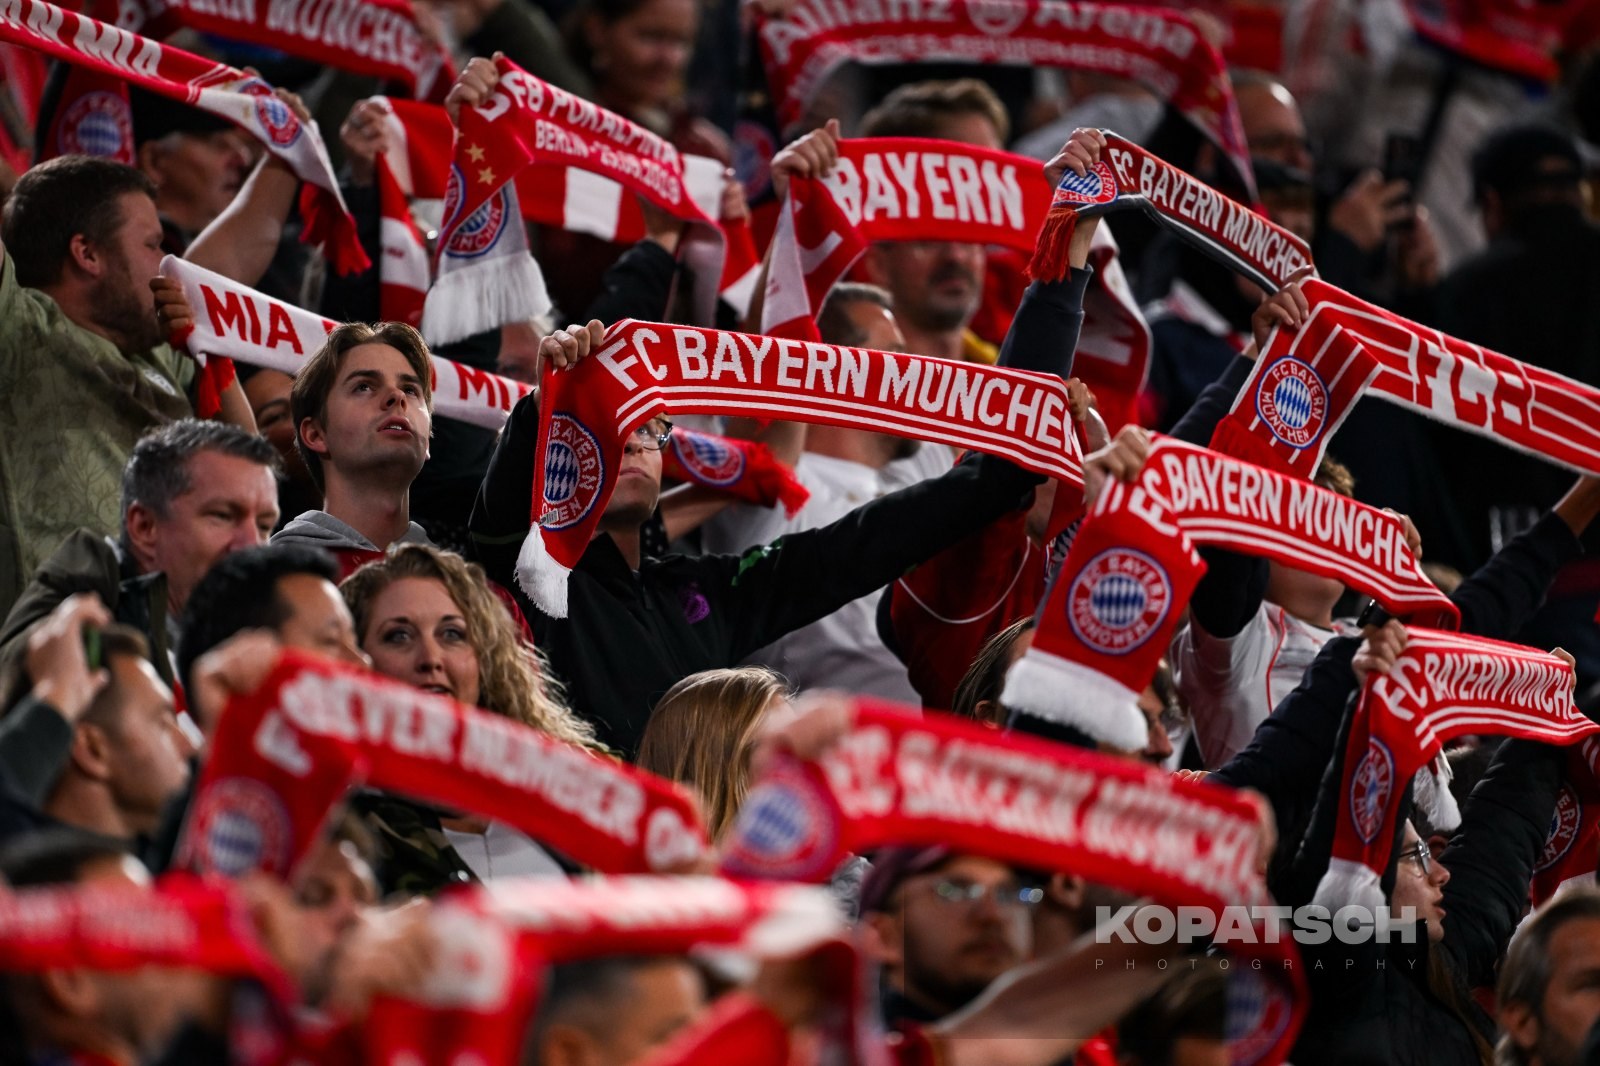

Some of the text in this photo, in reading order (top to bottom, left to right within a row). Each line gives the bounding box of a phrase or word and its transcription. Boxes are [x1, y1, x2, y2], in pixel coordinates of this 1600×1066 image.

[73, 13, 179, 86] MIA
[820, 152, 1025, 231] BAYERN
[1109, 148, 1135, 188] FC
[1139, 157, 1222, 232] BAYERN
[199, 284, 304, 355] MIA
[596, 328, 668, 391] FC
[673, 329, 869, 399] BAYERN
[1290, 363, 1324, 420] BAYERN
[1262, 391, 1310, 443] MÜNCHEN
[1128, 468, 1178, 537] FC
[1162, 453, 1283, 525] BAYERN
[1372, 656, 1428, 721] FC
[1424, 652, 1511, 702] BAYERN
